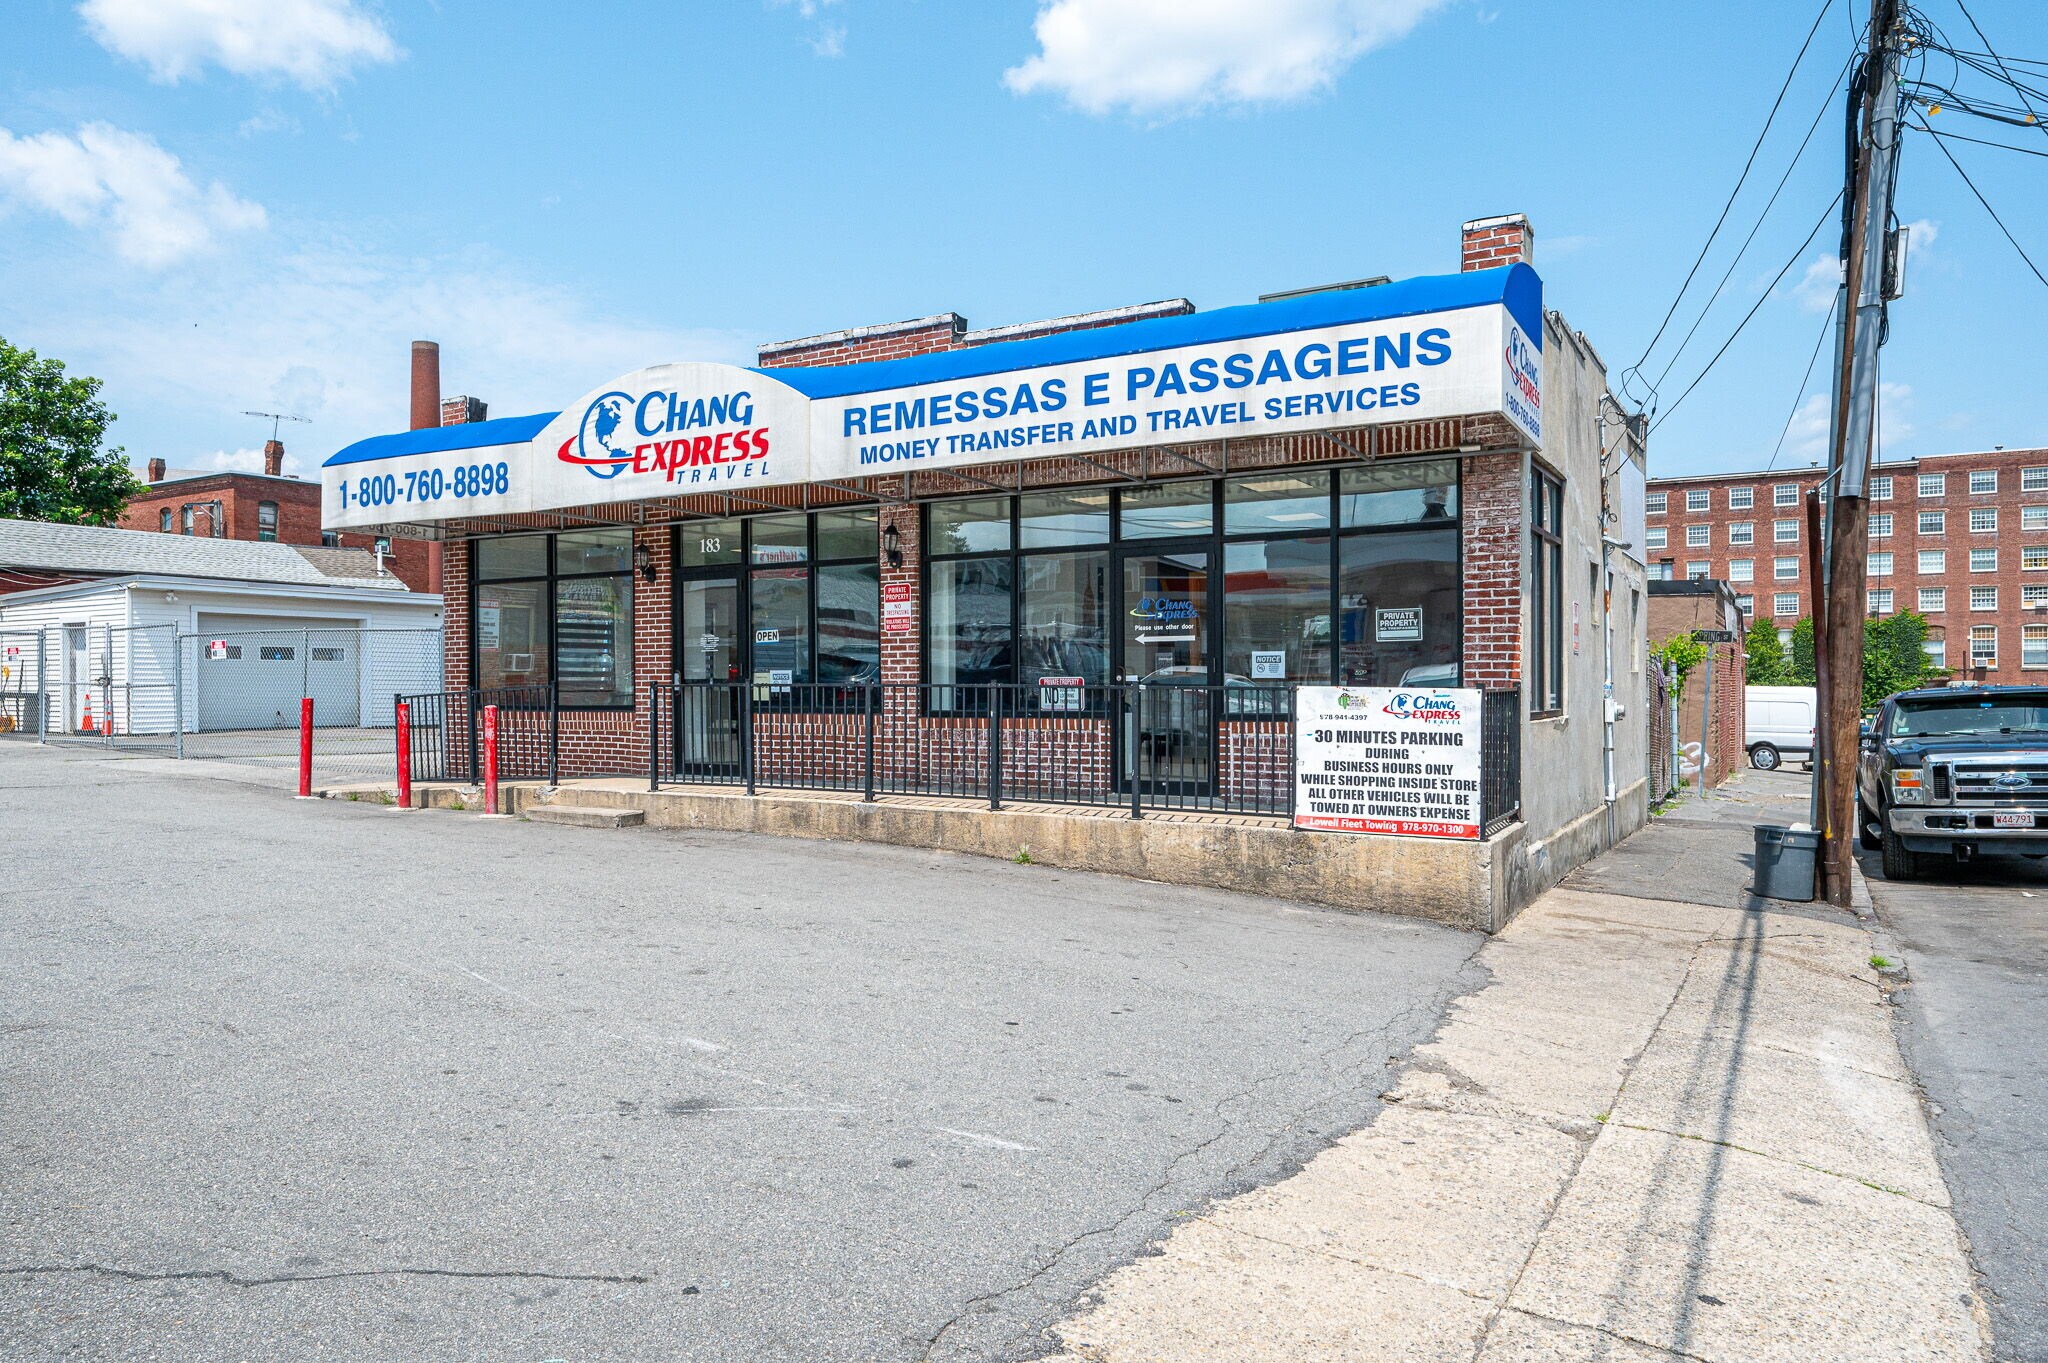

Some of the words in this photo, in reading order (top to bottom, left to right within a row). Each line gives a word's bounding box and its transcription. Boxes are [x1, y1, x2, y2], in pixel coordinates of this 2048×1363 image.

[1520, 342, 1538, 388] CHANG
[844, 379, 1067, 438] REMESSAS
[1083, 373, 1110, 407] E
[1127, 328, 1452, 401] PASSAGENS
[1519, 371, 1540, 409] EXPRESS
[635, 391, 754, 437] CHANG
[860, 437, 940, 465] MONEY
[947, 420, 1074, 454] TRANSFER
[1082, 414, 1137, 440] AND
[1147, 401, 1256, 432] TRAVEL
[1265, 382, 1421, 420] SERVICES
[1506, 392, 1540, 438] 1-800-760-8898
[633, 428, 770, 482] EXPRESS
[677, 461, 769, 485] TRAVEL
[339, 462, 509, 509] 1-800-760-8898
[699, 538, 720, 553] 183
[1155, 597, 1193, 612] CHANG
[1380, 619, 1418, 627] PROPERTY
[757, 631, 778, 642] OPEN
[1413, 695, 1456, 711] CHANG
[1411, 709, 1461, 724] EXPRESS
[1315, 729, 1332, 743] 30
[1336, 731, 1397, 745] MINUTES
[1401, 732, 1463, 746] PARKING
[1365, 748, 1409, 760] DURING
[1324, 761, 1379, 773] BUSINESS
[1382, 763, 1422, 775] HOURS
[1425, 764, 1453, 776] ONLY
[1301, 773, 1336, 786] WHILE
[1338, 775, 1396, 788] SHOPPING
[1398, 777, 1438, 790] INSIDE
[1440, 779, 1477, 792] STORE
[1308, 787, 1327, 799] ALL
[1329, 788, 1365, 801] OTHER
[1367, 790, 1421, 804] VEHICLES
[1424, 791, 1452, 805] WILL
[1455, 793, 1470, 806] BE
[1310, 801, 1349, 814] TOWED
[1352, 803, 1366, 815] AT
[1368, 804, 1418, 818] OWNERS
[1420, 806, 1470, 820] EXPENSE
[1309, 817, 1338, 827] Lowell
[1341, 819, 1362, 829] Fleet
[1366, 821, 1398, 832] Towing
[1402, 822, 1464, 834] 978-970-1300
